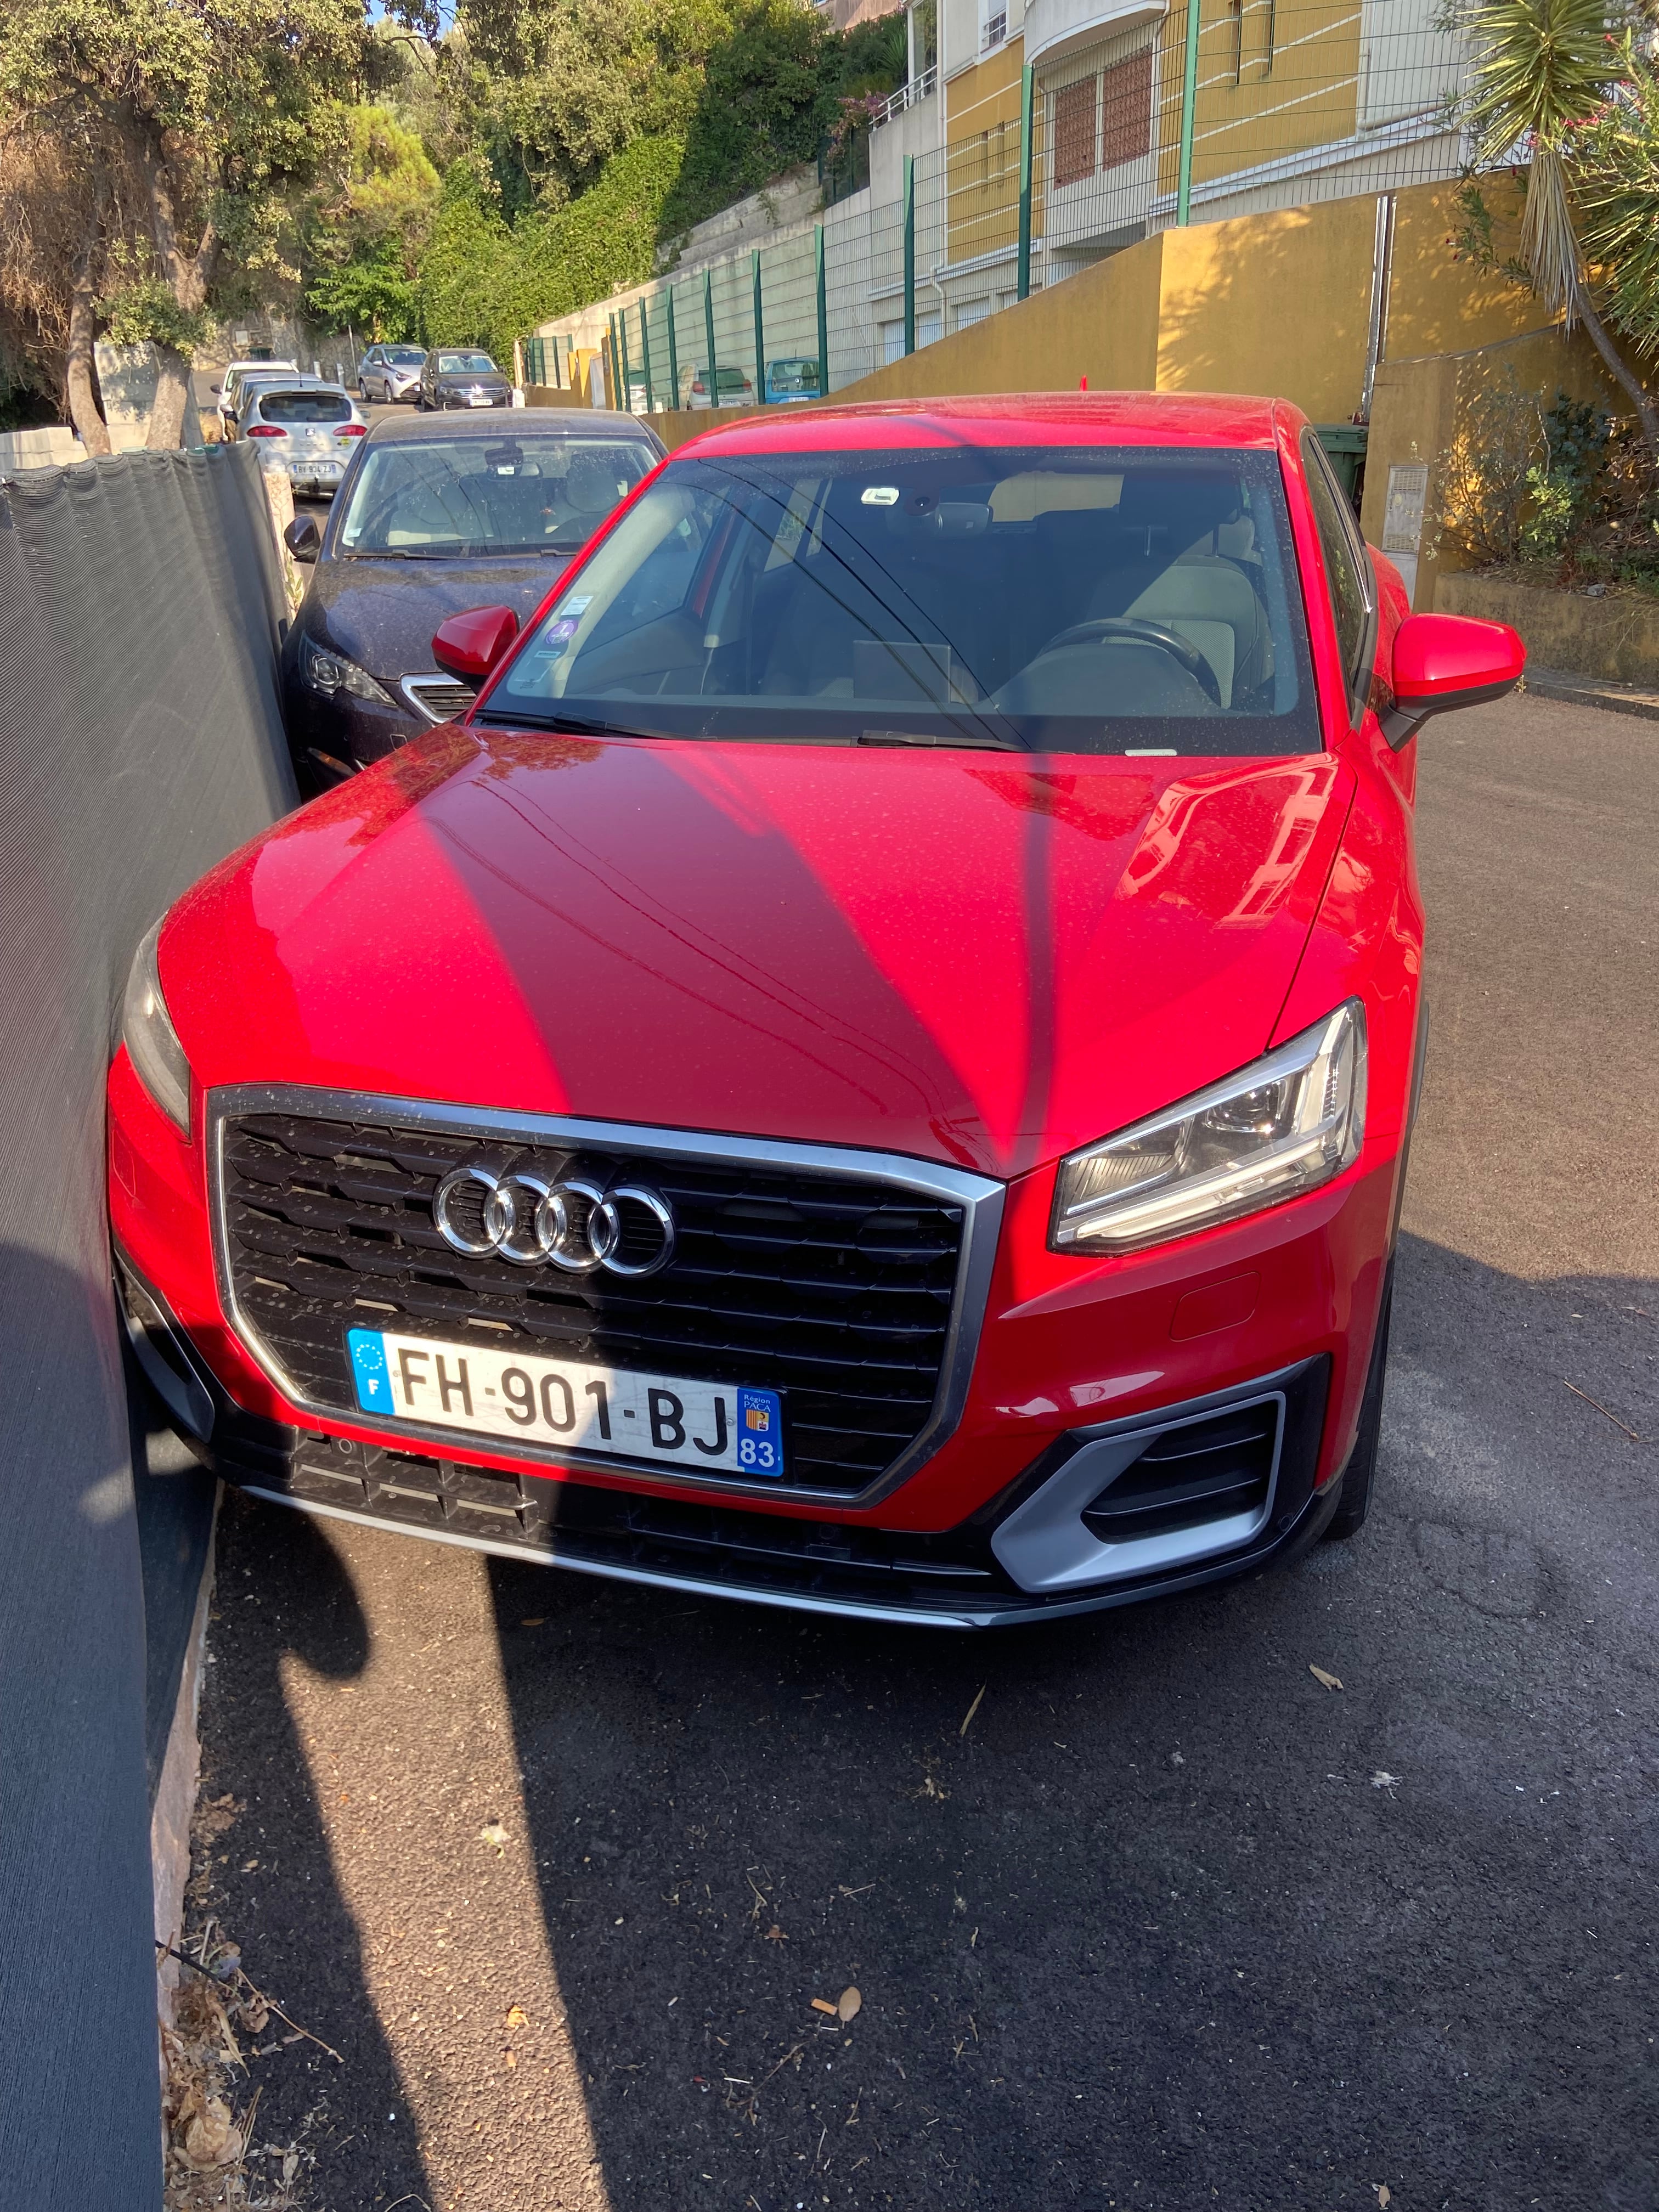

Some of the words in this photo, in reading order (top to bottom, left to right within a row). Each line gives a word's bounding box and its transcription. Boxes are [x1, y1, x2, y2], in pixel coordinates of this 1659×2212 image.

[368, 1379, 380, 1395] F
[398, 1347, 728, 1456] FH-901-BJ
[743, 1393, 771, 1404] Région
[743, 1400, 771, 1413] PACA
[740, 1438, 775, 1468] 83
